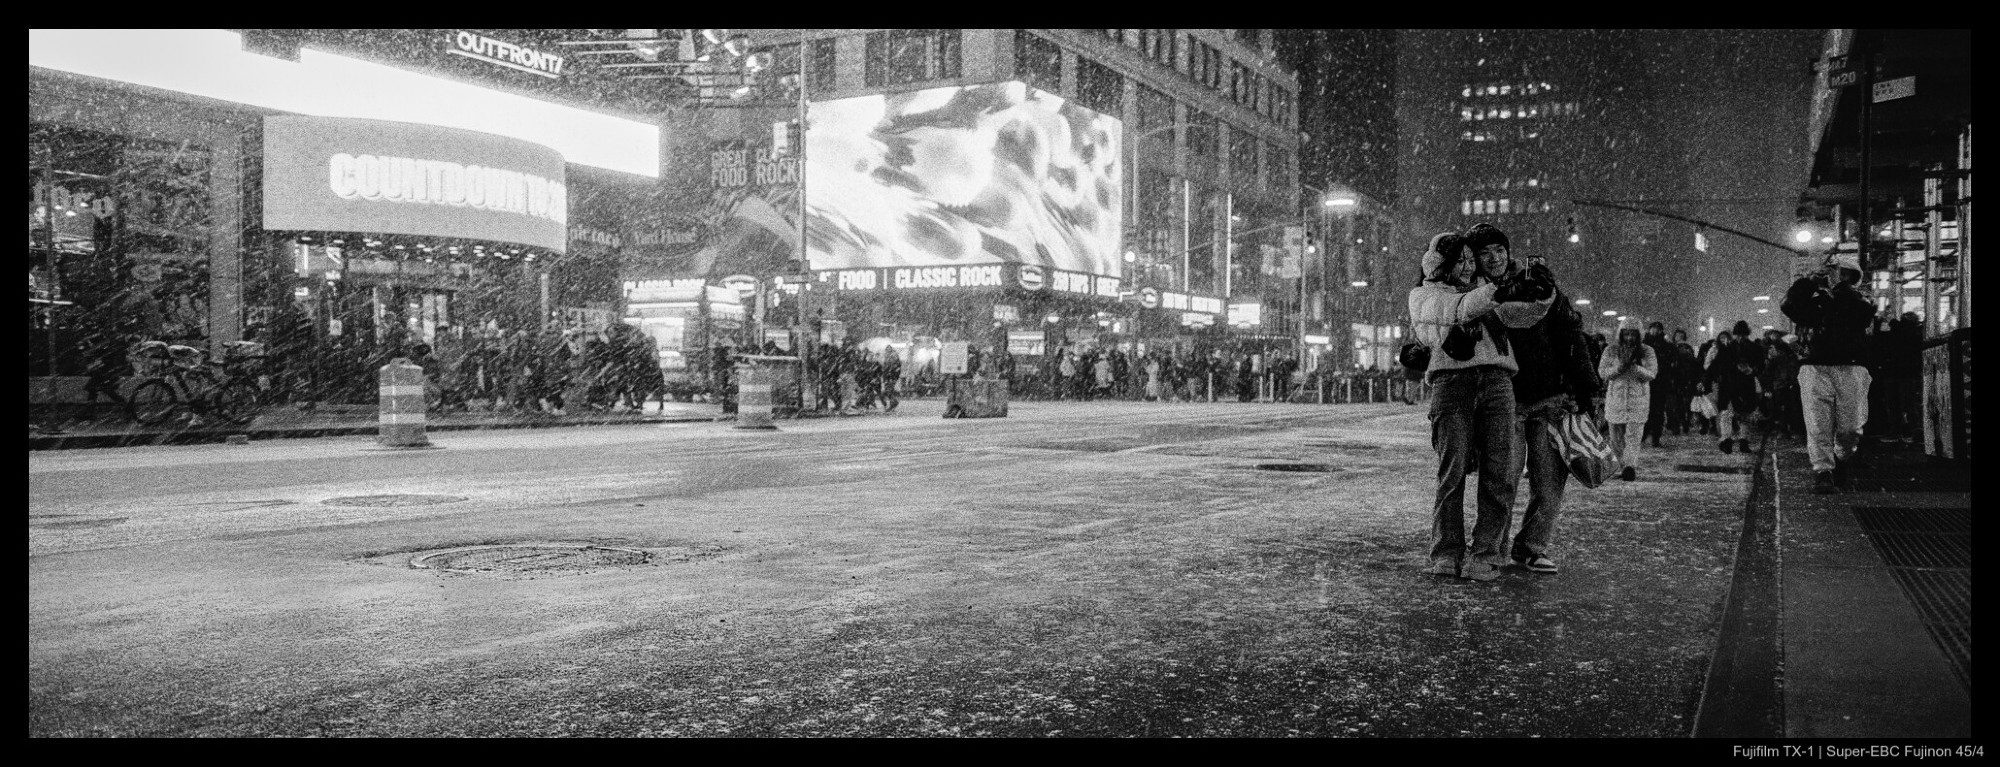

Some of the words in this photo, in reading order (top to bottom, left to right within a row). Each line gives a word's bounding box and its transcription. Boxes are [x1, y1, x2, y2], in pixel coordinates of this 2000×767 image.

[1831, 72, 1855, 86] M20
[330, 153, 527, 214] COUNTDOWN
[712, 167, 748, 188] FOOD
[756, 159, 800, 186] ROCK
[838, 270, 877, 291] FOOD
[895, 267, 957, 289] CLASSIC
[958, 265, 1003, 287] ROCK
